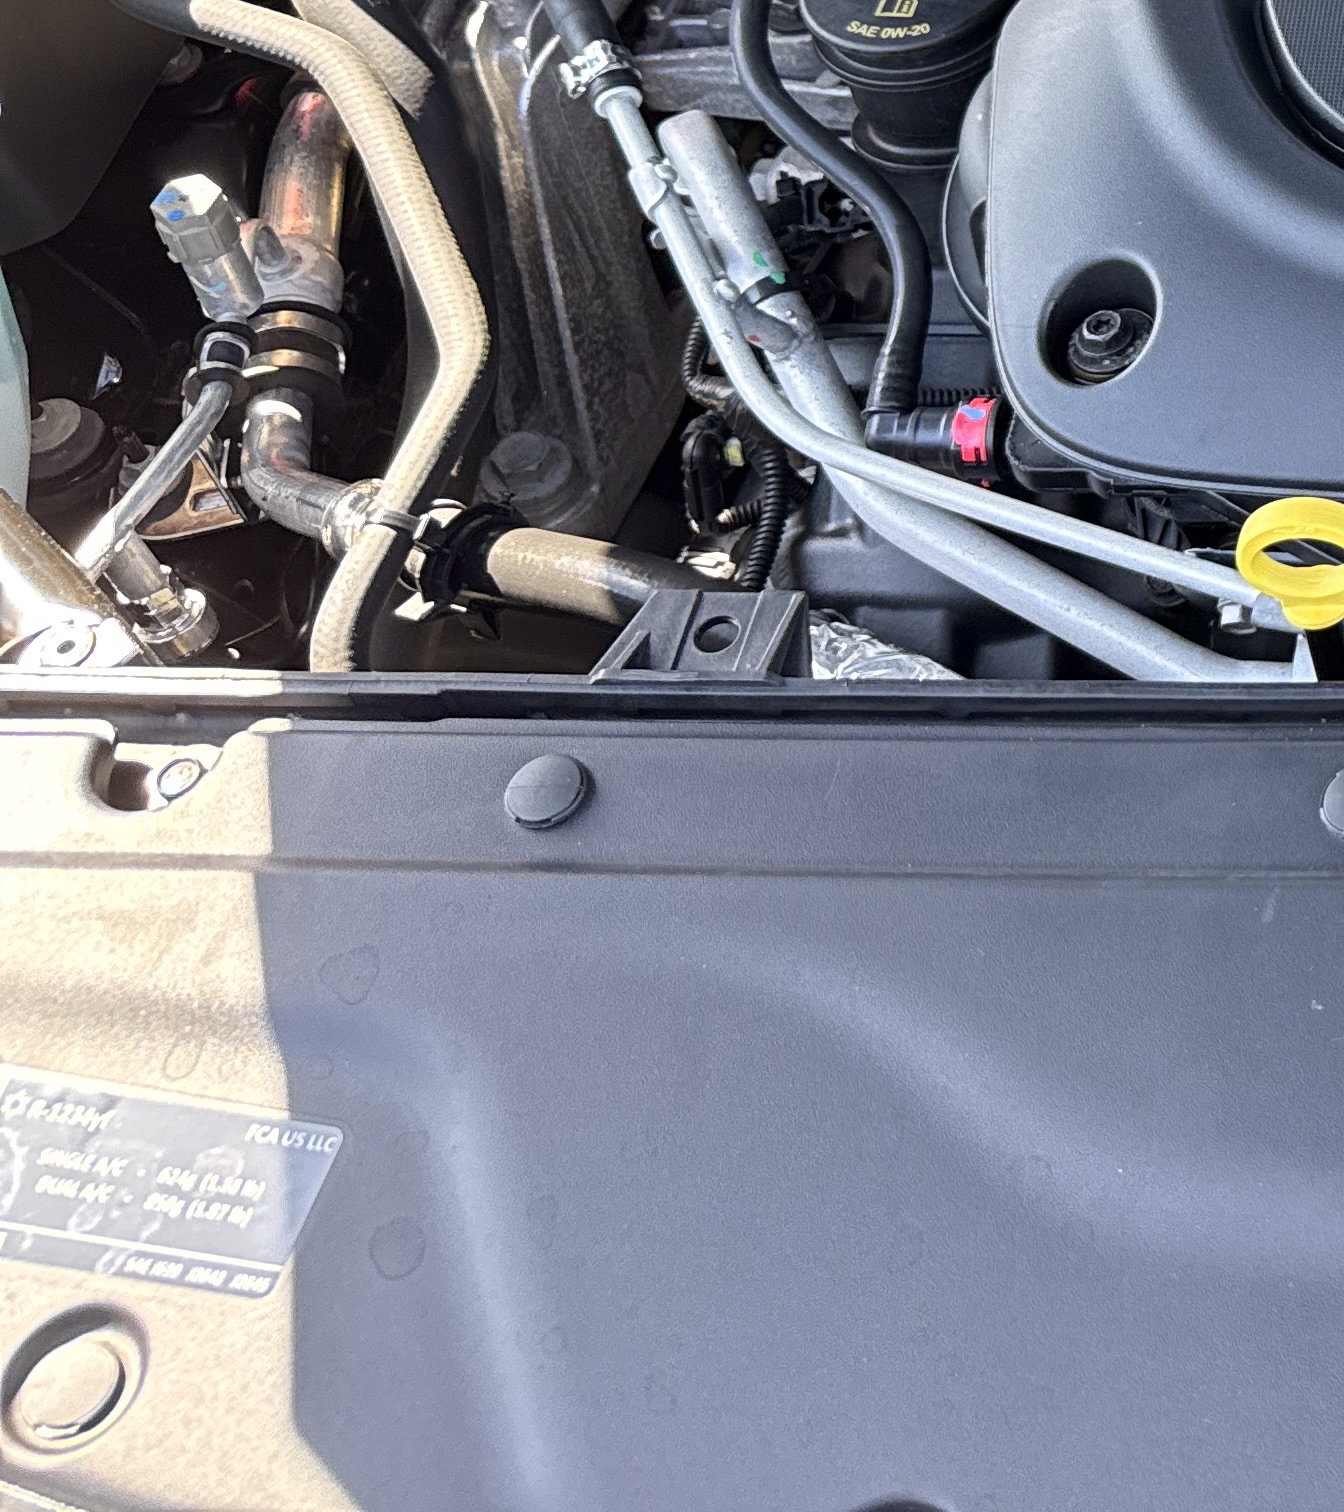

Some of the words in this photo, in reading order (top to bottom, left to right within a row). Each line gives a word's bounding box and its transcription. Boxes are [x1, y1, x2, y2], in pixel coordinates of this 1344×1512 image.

[846, 19, 880, 39] SAE
[880, 21, 931, 39] 0W-20
[26, 1098, 117, 1132] R-1234yf
[244, 1123, 280, 1145] FCA
[281, 1129, 307, 1148] US
[306, 1134, 339, 1153] LLC
[34, 1174, 82, 1199] DUAL
